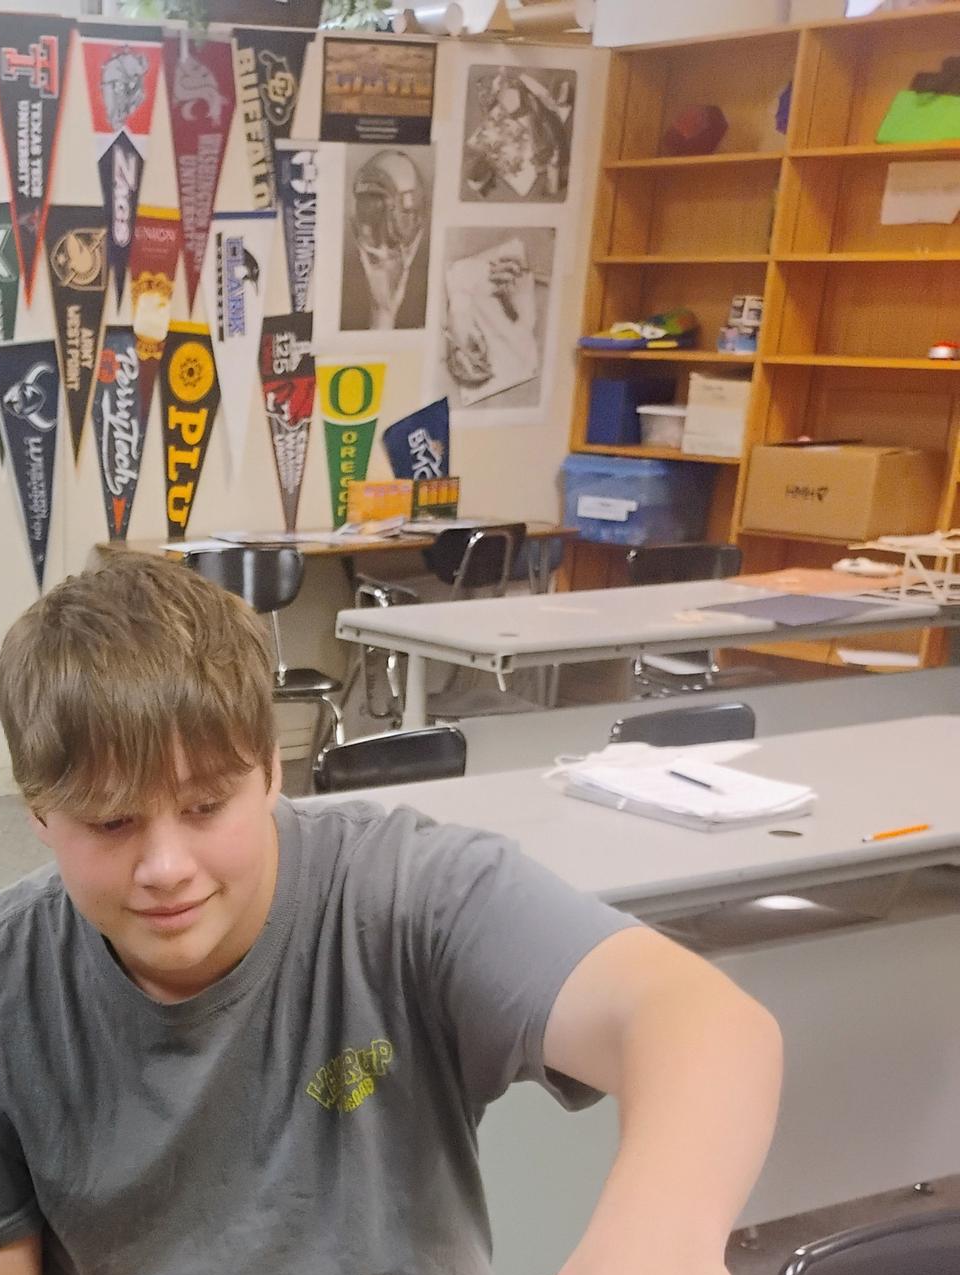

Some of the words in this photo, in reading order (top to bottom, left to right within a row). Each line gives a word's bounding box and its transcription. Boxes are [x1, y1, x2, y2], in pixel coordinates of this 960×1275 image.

[17, 100, 30, 197] UNIVERSITY
[30, 101, 43, 155] TEXAS
[30, 158, 43, 198] TECH
[330, 366, 373, 416] O
[168, 405, 208, 527] PLU
